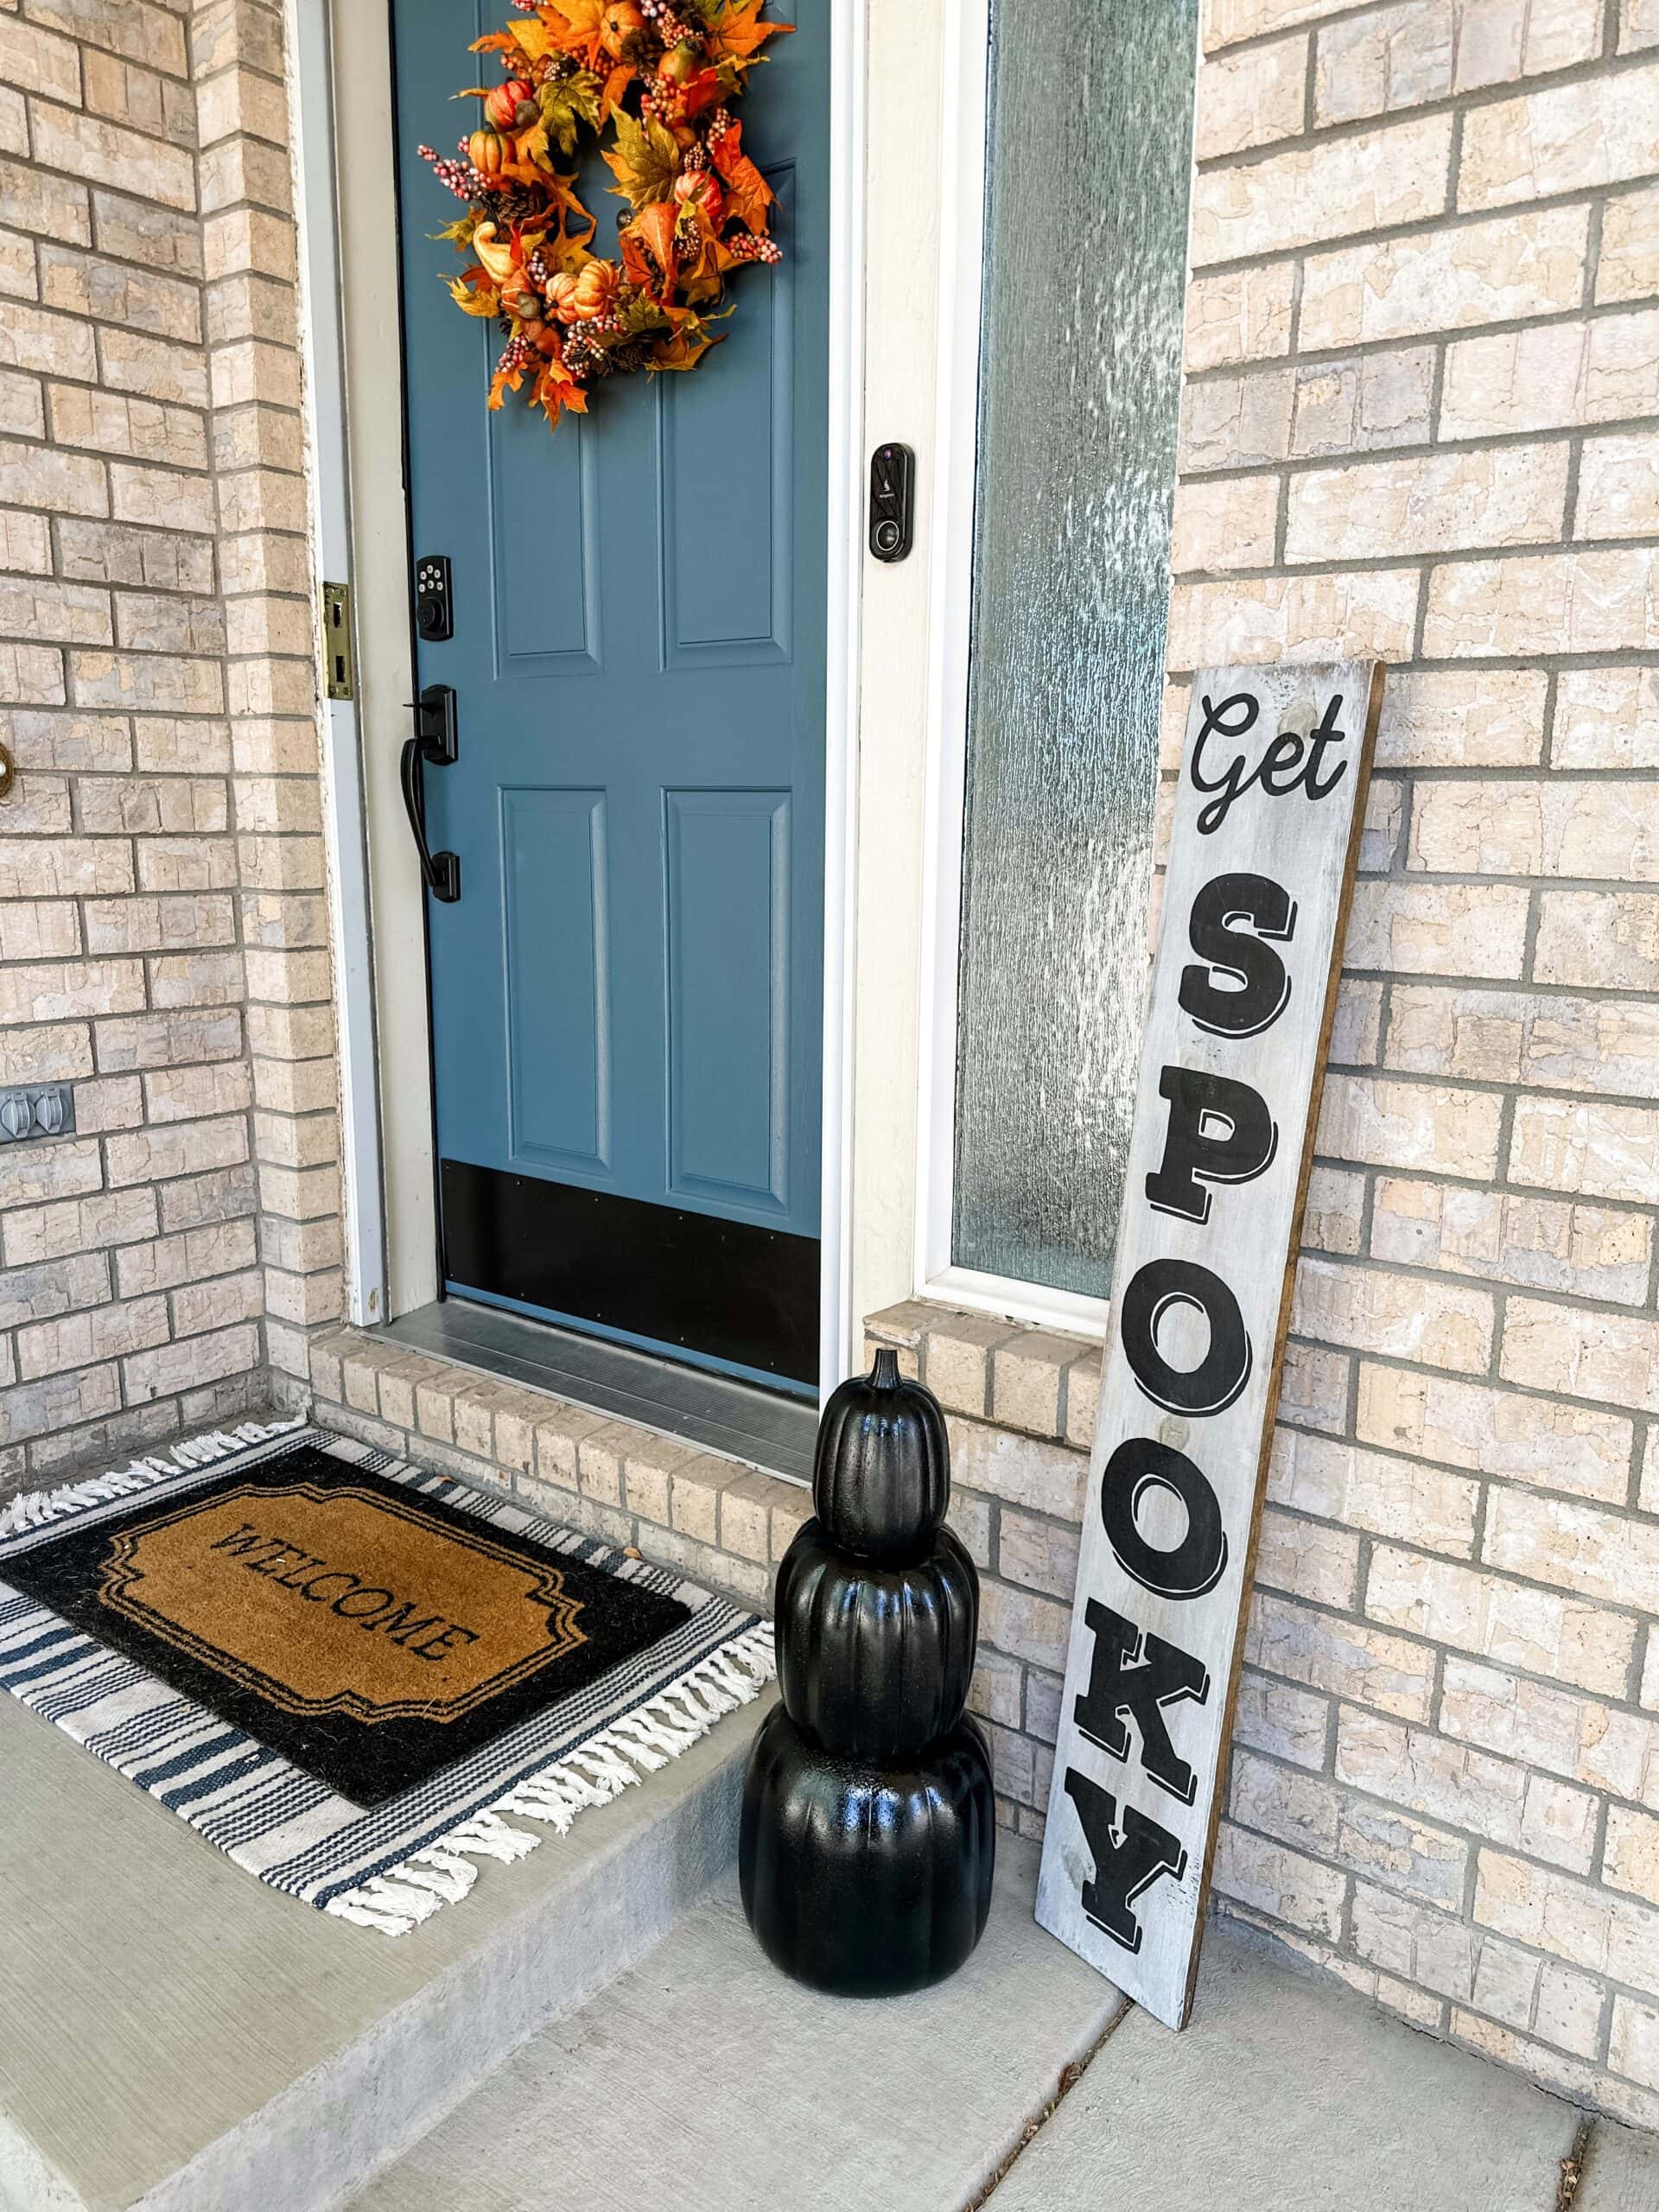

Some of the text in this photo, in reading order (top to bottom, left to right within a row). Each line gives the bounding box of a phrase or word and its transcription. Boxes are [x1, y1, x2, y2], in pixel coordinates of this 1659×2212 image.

[1191, 693, 1347, 835] Get
[1065, 873, 1298, 1955] SPOOKY
[210, 1523, 480, 1661] WELCOME
